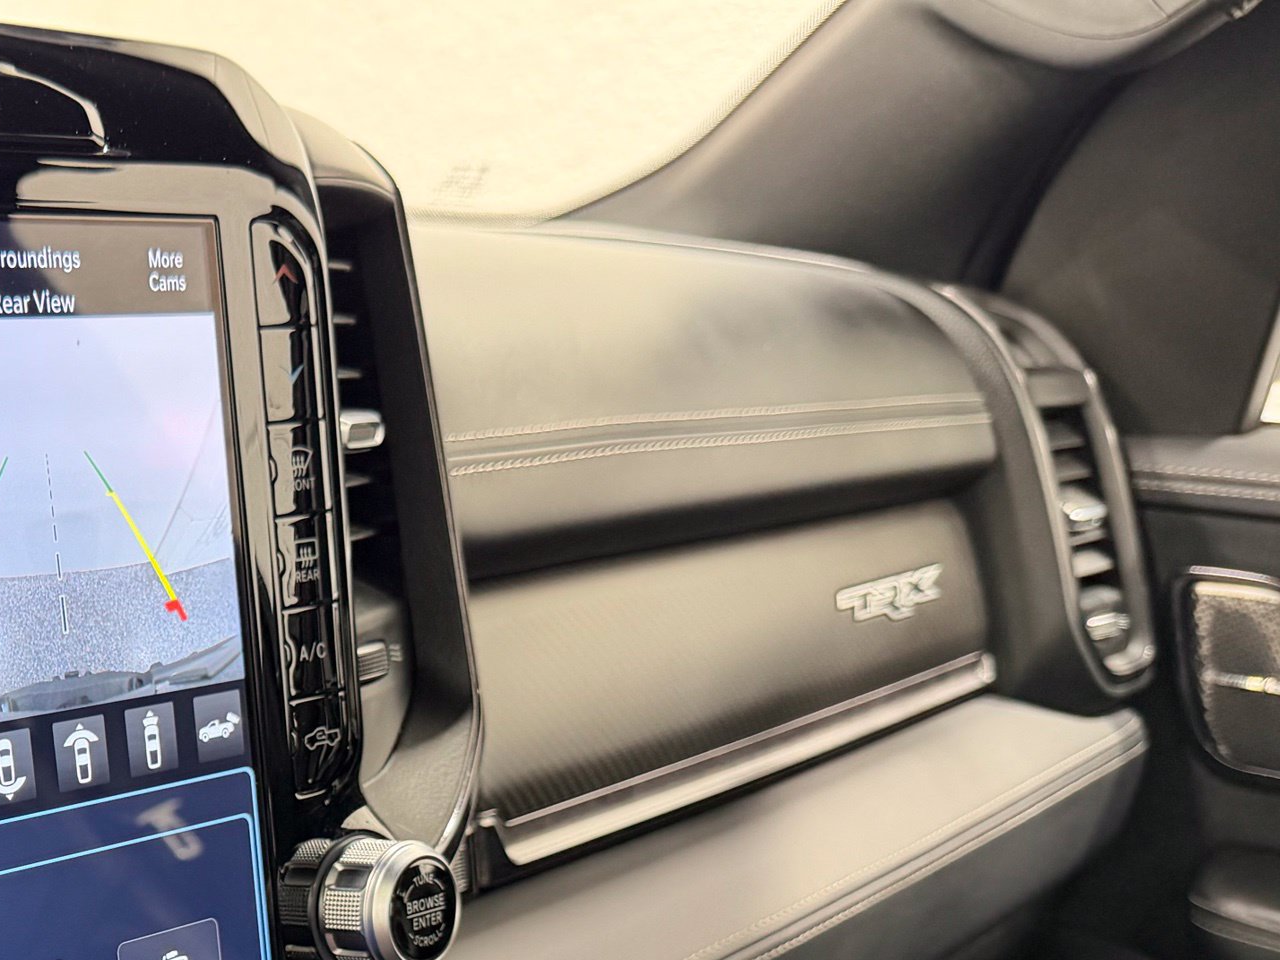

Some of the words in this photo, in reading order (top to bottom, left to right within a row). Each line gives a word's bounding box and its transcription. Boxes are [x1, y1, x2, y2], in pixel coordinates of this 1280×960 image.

[148, 247, 184, 270] More
[149, 271, 188, 293] Cams
[32, 289, 77, 314] View
[296, 569, 320, 583] REAR
[835, 562, 944, 622] TRX
[299, 642, 327, 662] A/C
[412, 873, 435, 888] TUNE
[406, 892, 446, 915] BROWSE
[412, 911, 443, 931] ENTER
[412, 929, 443, 947] SCROLL
